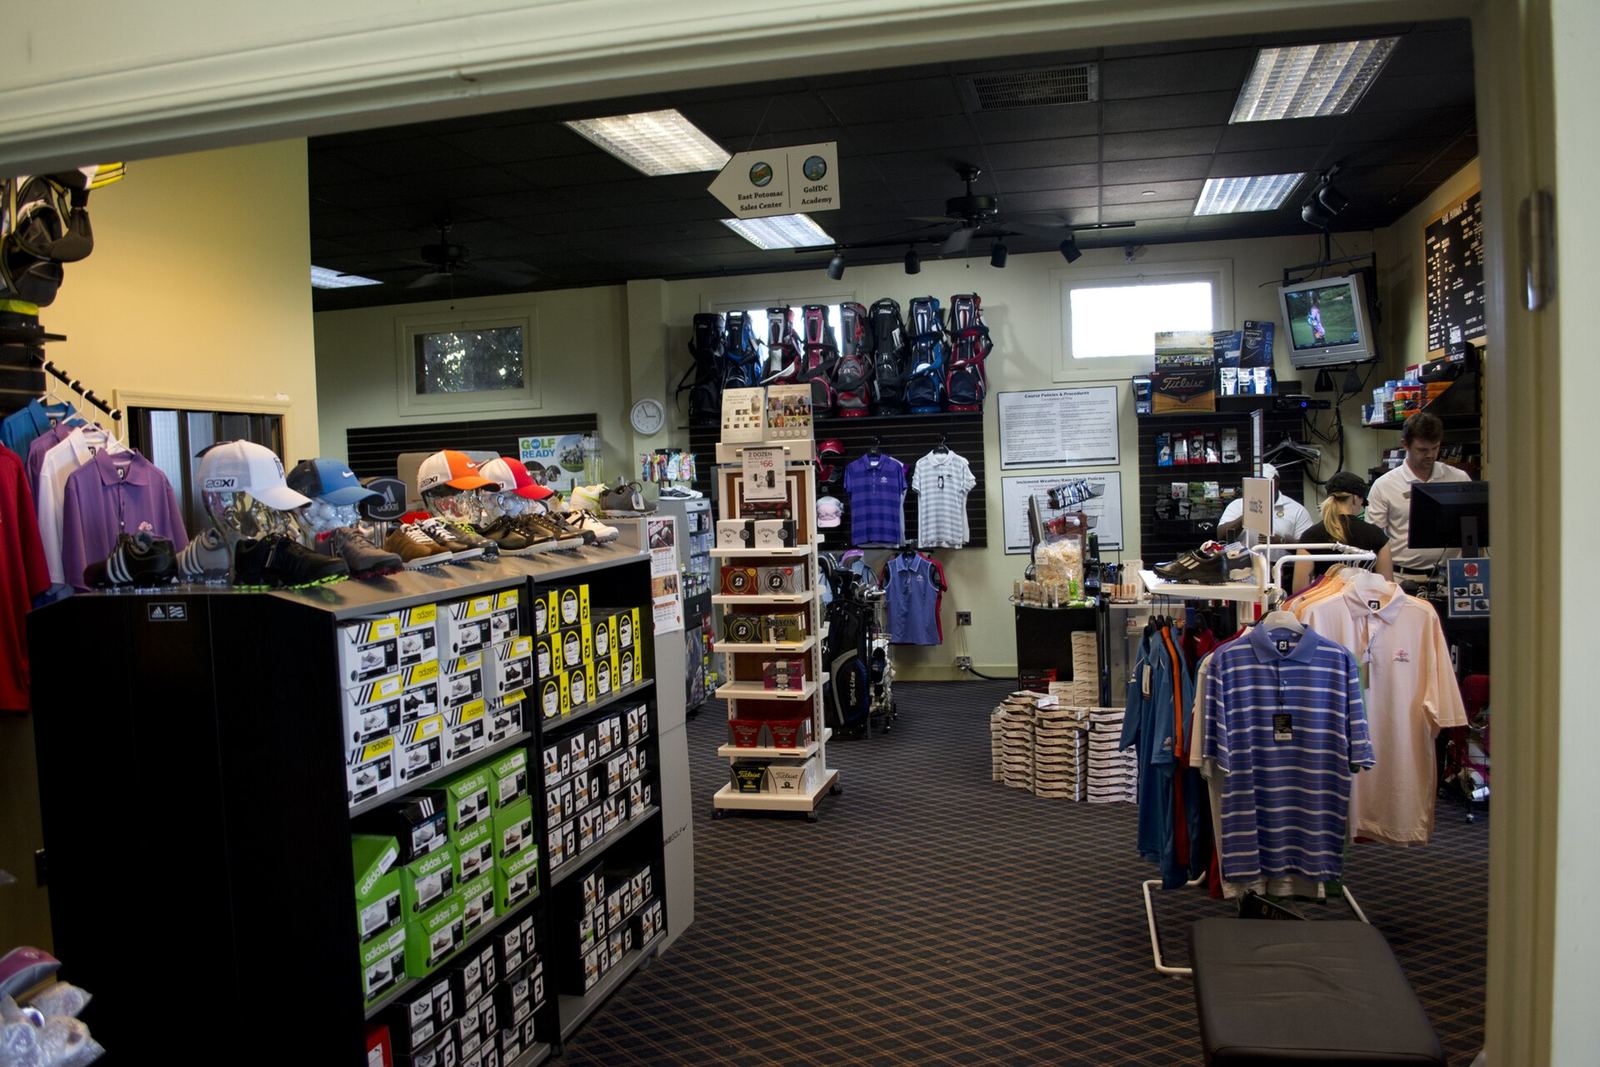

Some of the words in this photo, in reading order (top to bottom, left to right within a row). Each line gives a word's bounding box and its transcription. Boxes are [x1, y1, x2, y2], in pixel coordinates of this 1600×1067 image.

[804, 184, 829, 194] GolfDC
[754, 190, 784, 199] Potomac
[801, 196, 833, 205] Academy
[740, 204, 758, 212] Sales
[1160, 376, 1206, 391] Titleist
[521, 438, 556, 450] GOLF
[522, 448, 556, 459] READY
[738, 770, 761, 778] Titleist
[419, 856, 442, 873] adidas
